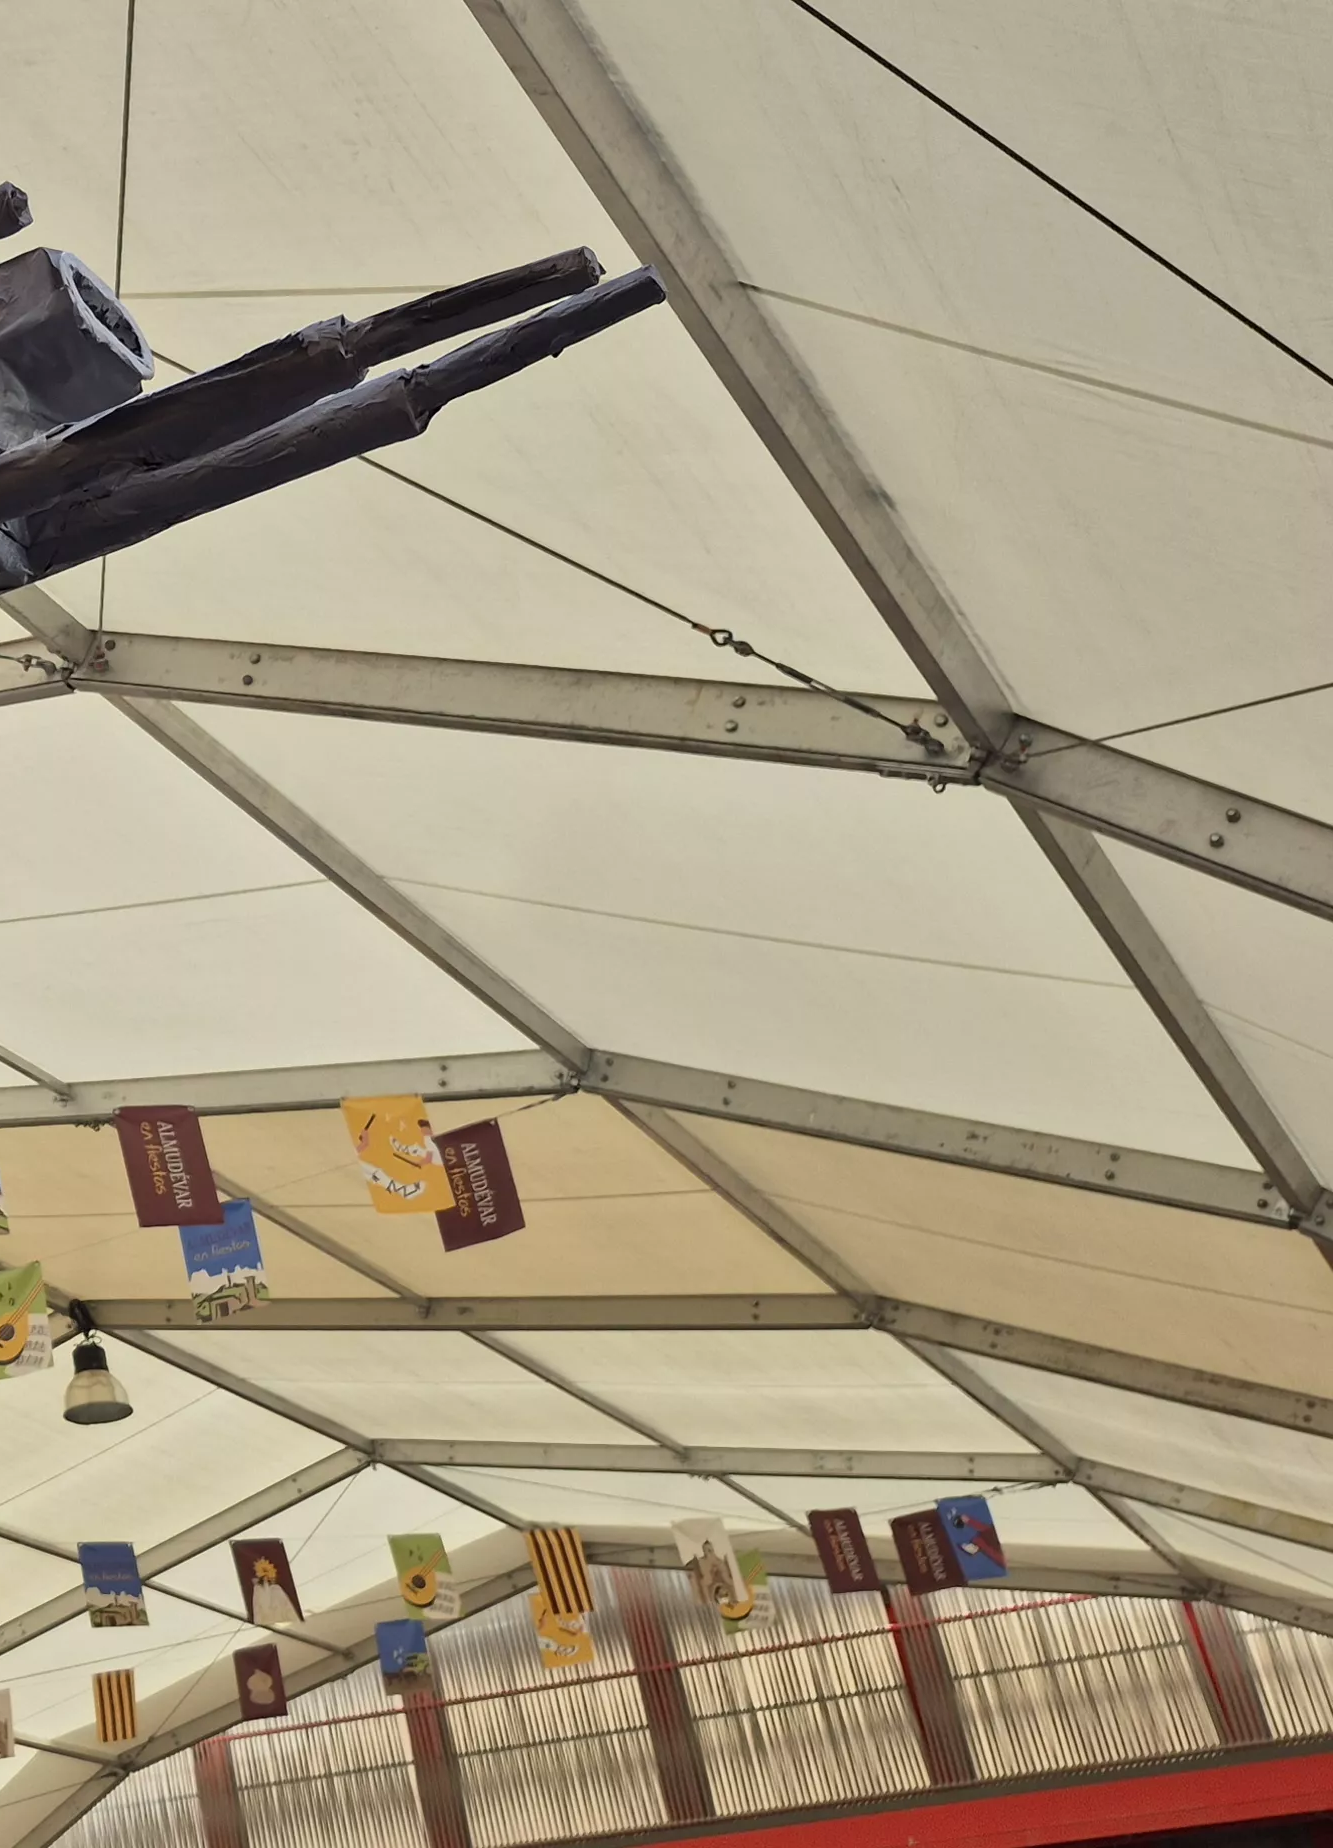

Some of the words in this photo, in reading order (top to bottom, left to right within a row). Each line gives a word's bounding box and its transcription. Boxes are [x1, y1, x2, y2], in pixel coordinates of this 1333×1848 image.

[140, 1121, 153, 1141] en
[444, 1147, 457, 1165] en
[145, 1144, 167, 1195] fiestas
[156, 1121, 193, 1209] ALMUDÉVAR
[460, 1142, 497, 1227] ALMUDÉVAR
[449, 1167, 471, 1217] fiestas
